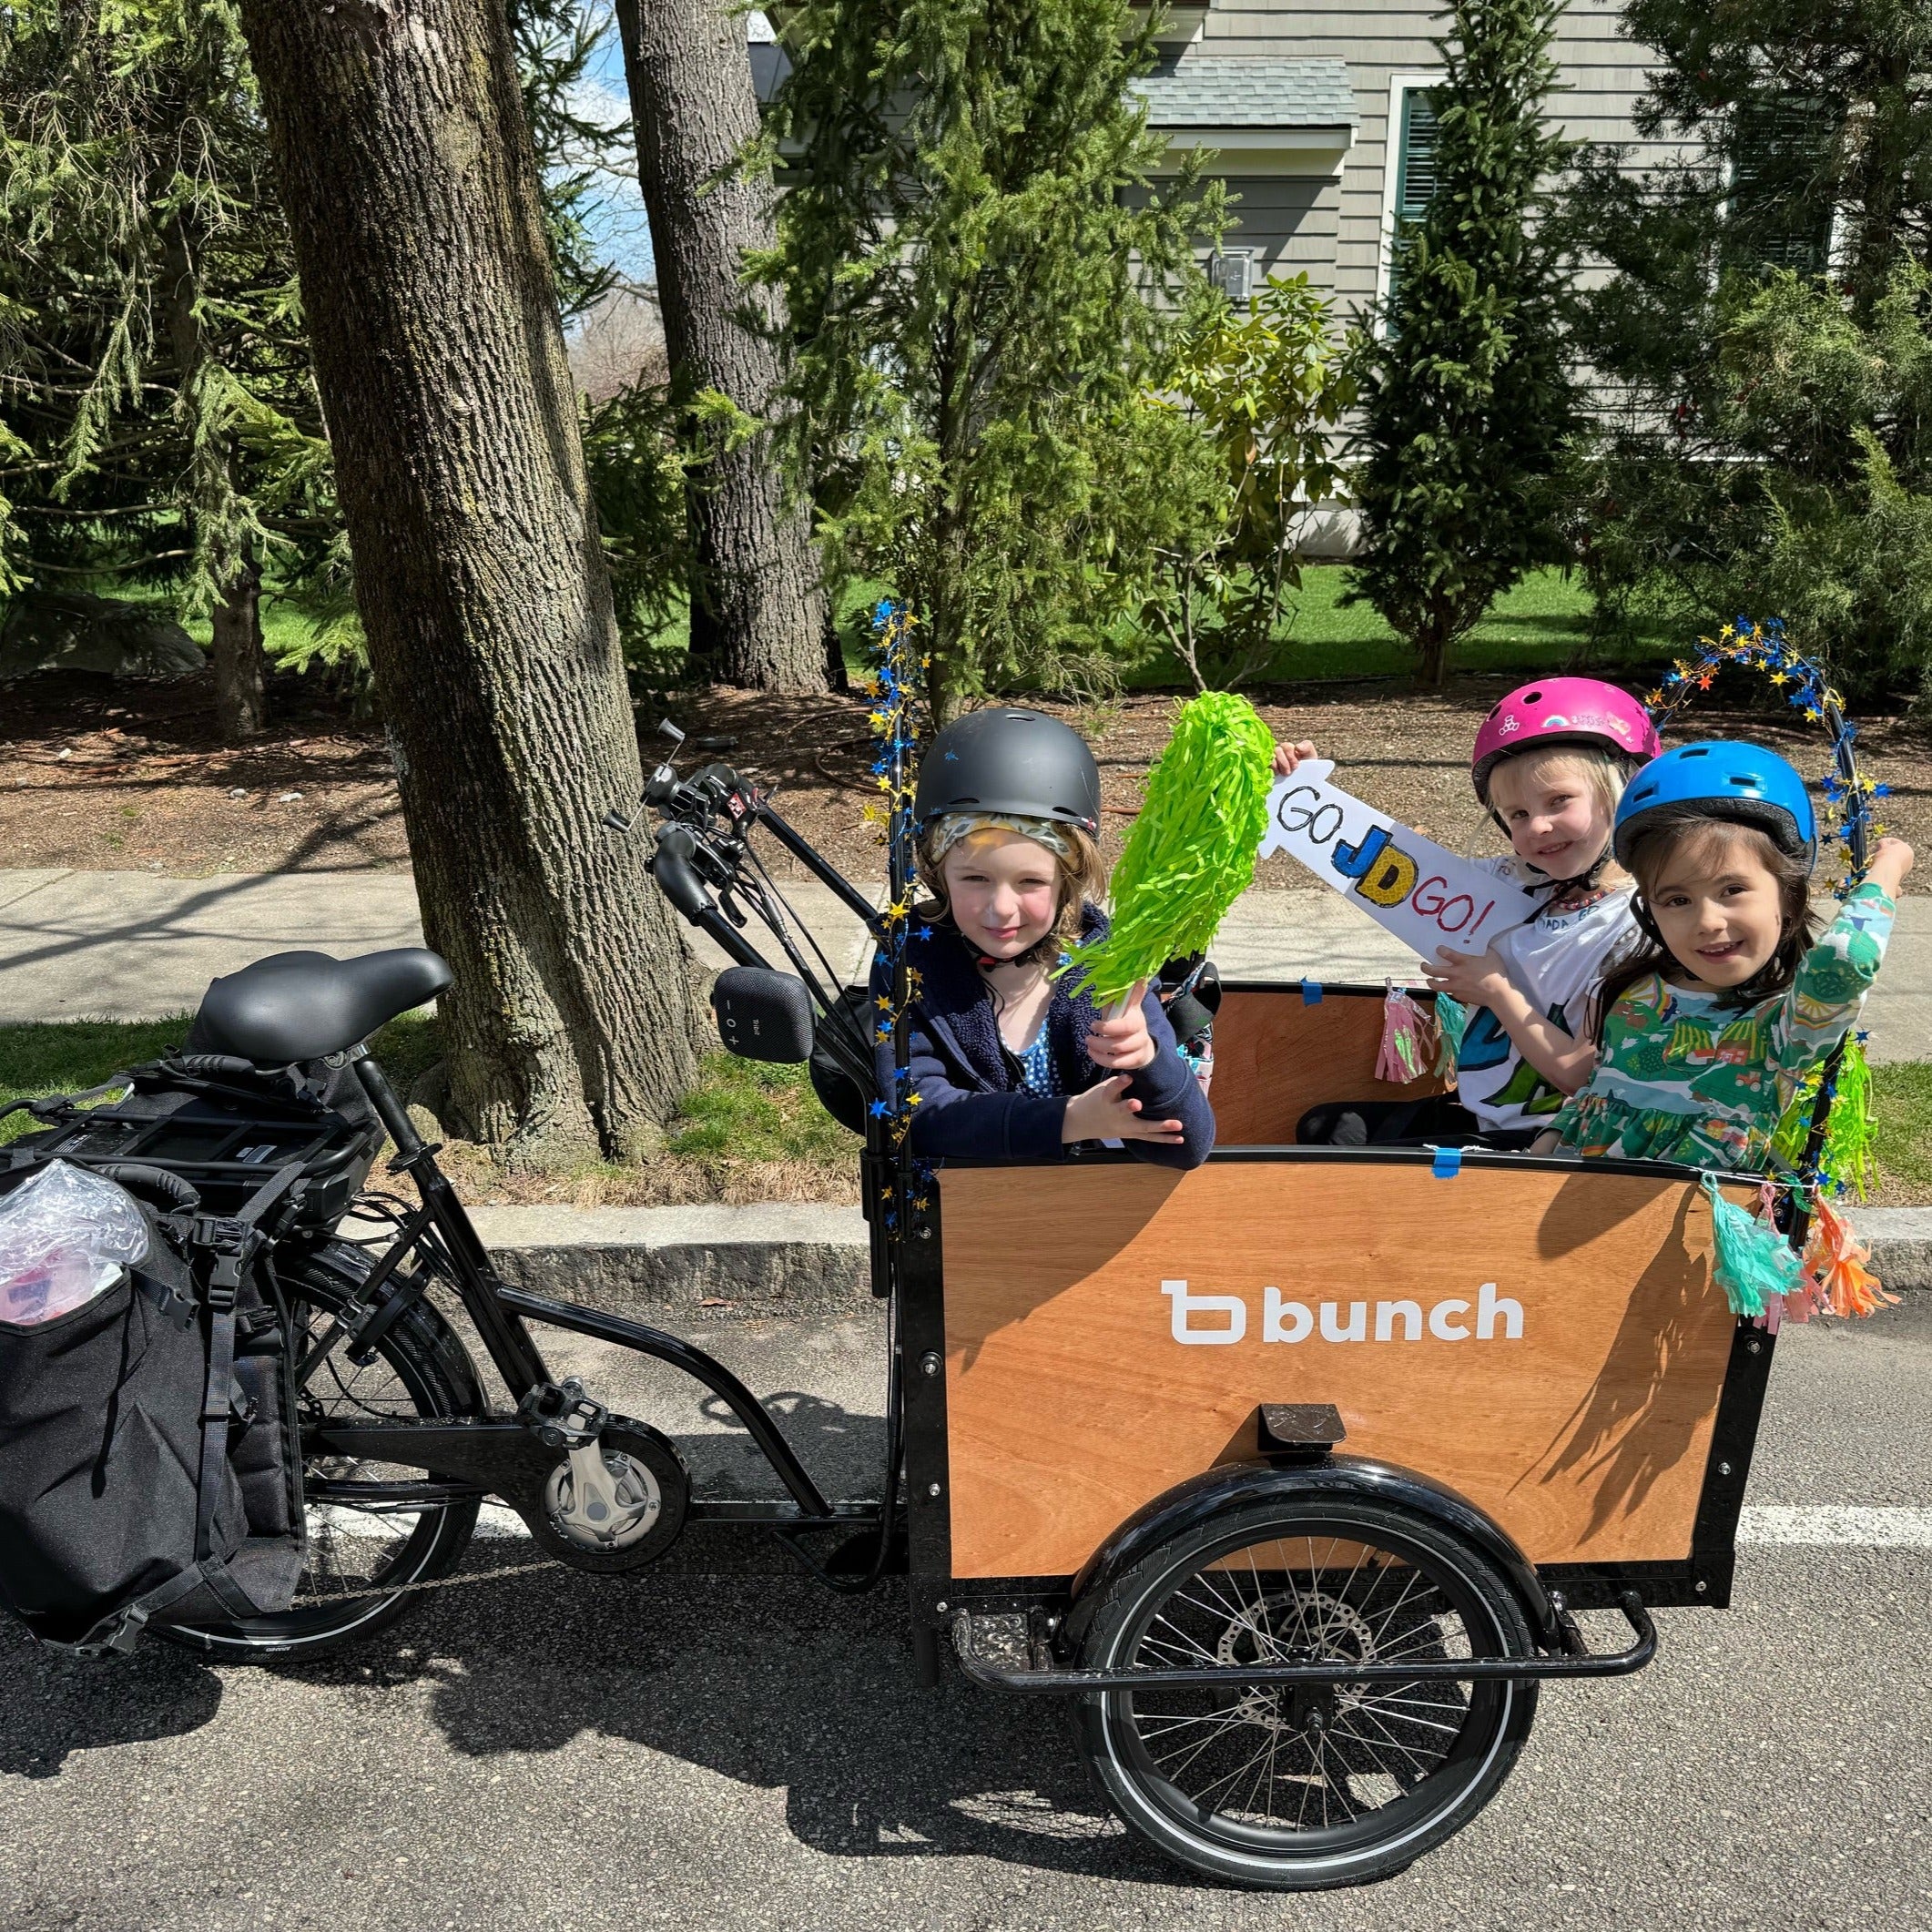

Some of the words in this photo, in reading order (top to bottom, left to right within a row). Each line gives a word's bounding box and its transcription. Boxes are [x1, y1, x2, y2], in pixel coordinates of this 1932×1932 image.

[1277, 786, 1343, 844] GO
[1331, 824, 1419, 909] JD
[1411, 875, 1495, 943] GO!
[1263, 1282, 1524, 1344] bunch
